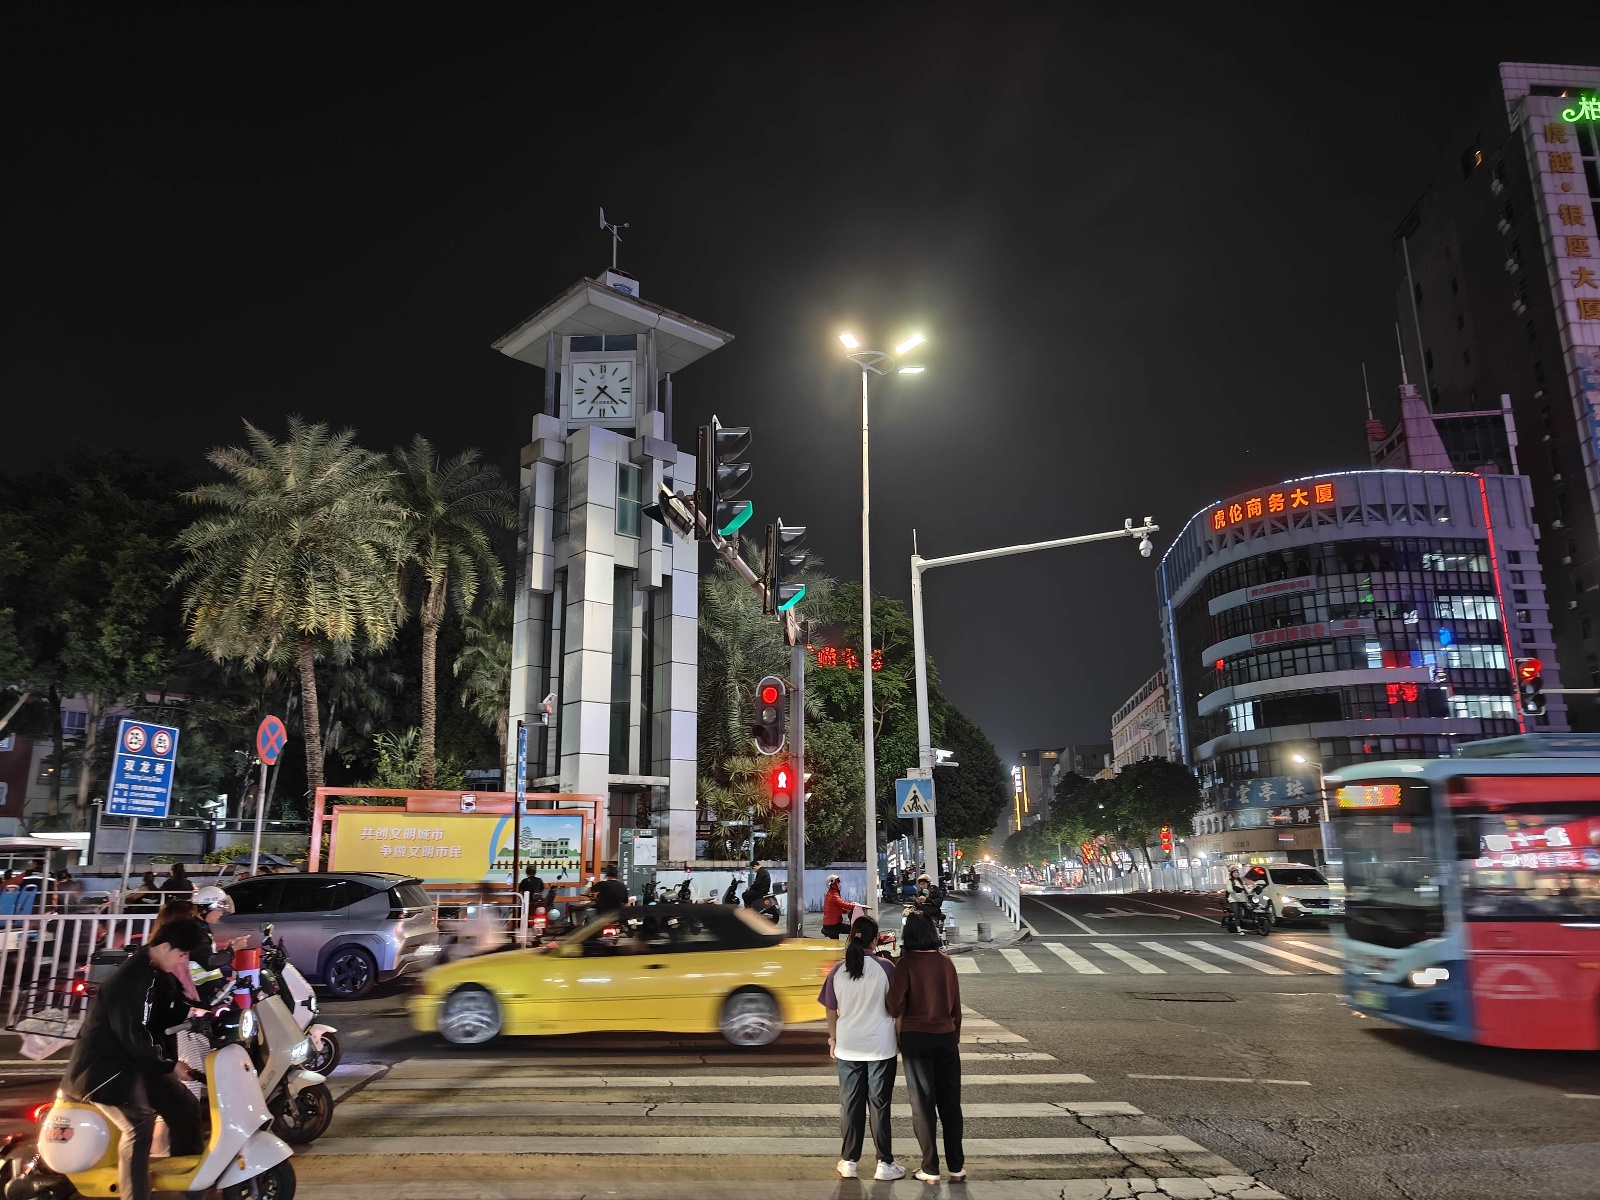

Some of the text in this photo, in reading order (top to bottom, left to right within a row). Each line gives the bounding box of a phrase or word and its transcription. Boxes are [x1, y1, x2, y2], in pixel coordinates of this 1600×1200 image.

[1214, 483, 1334, 530] 虎伦商务大厦
[123, 759, 165, 775] 双龙桥
[360, 827, 444, 841] 共创文明城市
[380, 845, 463, 859] 争做文明市民
